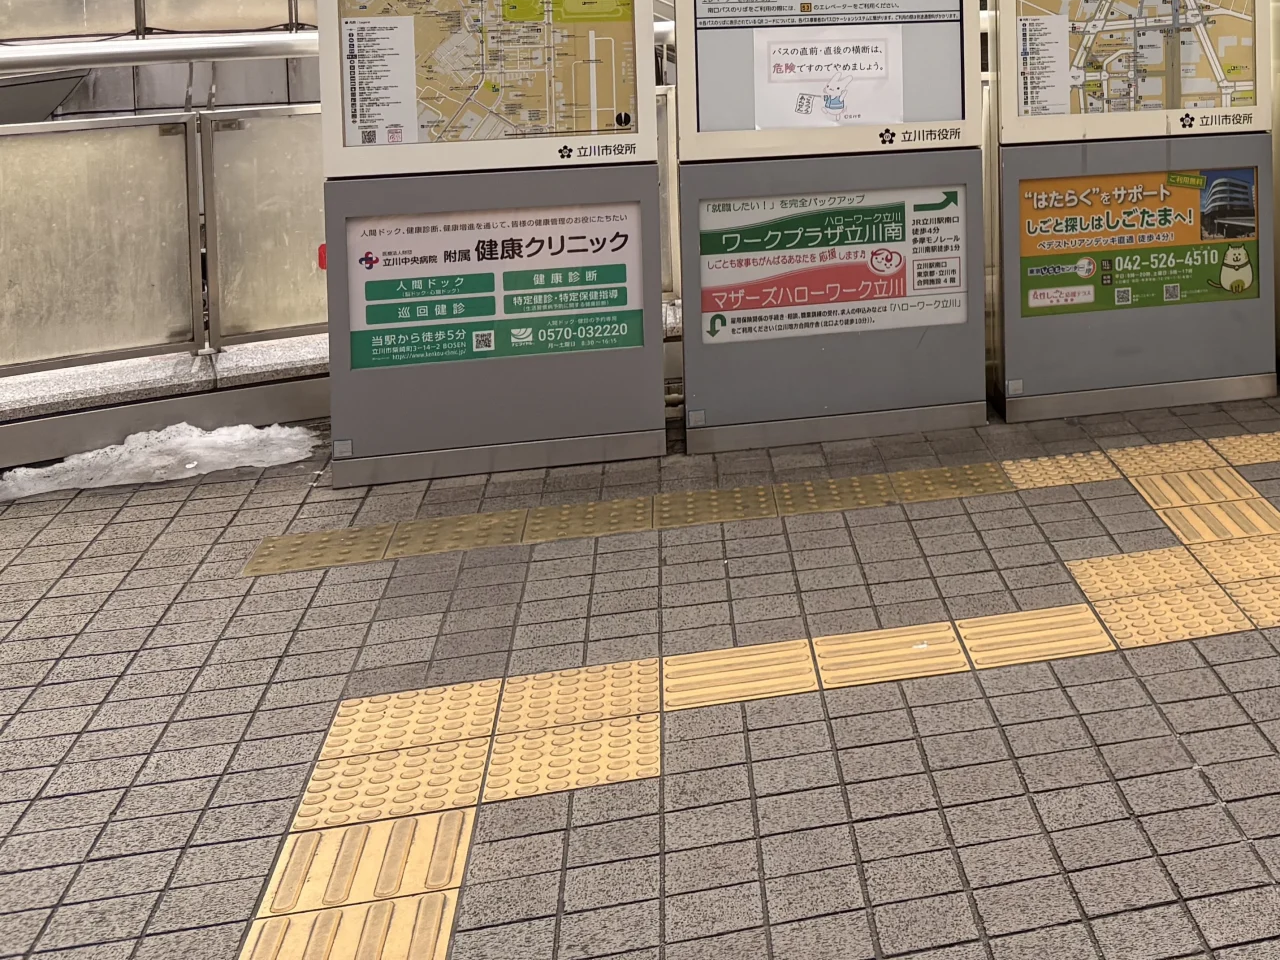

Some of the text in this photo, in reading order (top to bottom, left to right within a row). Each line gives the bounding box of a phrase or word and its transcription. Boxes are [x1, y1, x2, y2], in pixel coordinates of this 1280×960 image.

[772, 46, 883, 56] バスの直前・直後の横断は、
[772, 62, 884, 74] 危険ですのでやめましょう。
[1199, 113, 1253, 126] 立川市役所
[901, 128, 961, 142] 立川市役所
[576, 143, 637, 157] 立川市役所
[824, 212, 901, 225] ハローワーク立川
[911, 215, 960, 226] JR立川駅南口
[722, 223, 903, 252] ワークプラザ立川南
[912, 226, 940, 235] 徒歩4分
[912, 235, 960, 245] 多摩モノレール
[382, 231, 629, 267] 立川中央病院 附属 健康クリニック
[912, 244, 961, 254] 立川南駅徒歩1分
[1115, 249, 1219, 272] 042-526-4510
[533, 270, 598, 286] 健康診断
[712, 278, 904, 309] マザーズハローワーク立川
[398, 302, 466, 319] 巡回健診
[371, 329, 467, 346] 当駅から徒歩5分
[538, 323, 628, 342] 0570-032220
